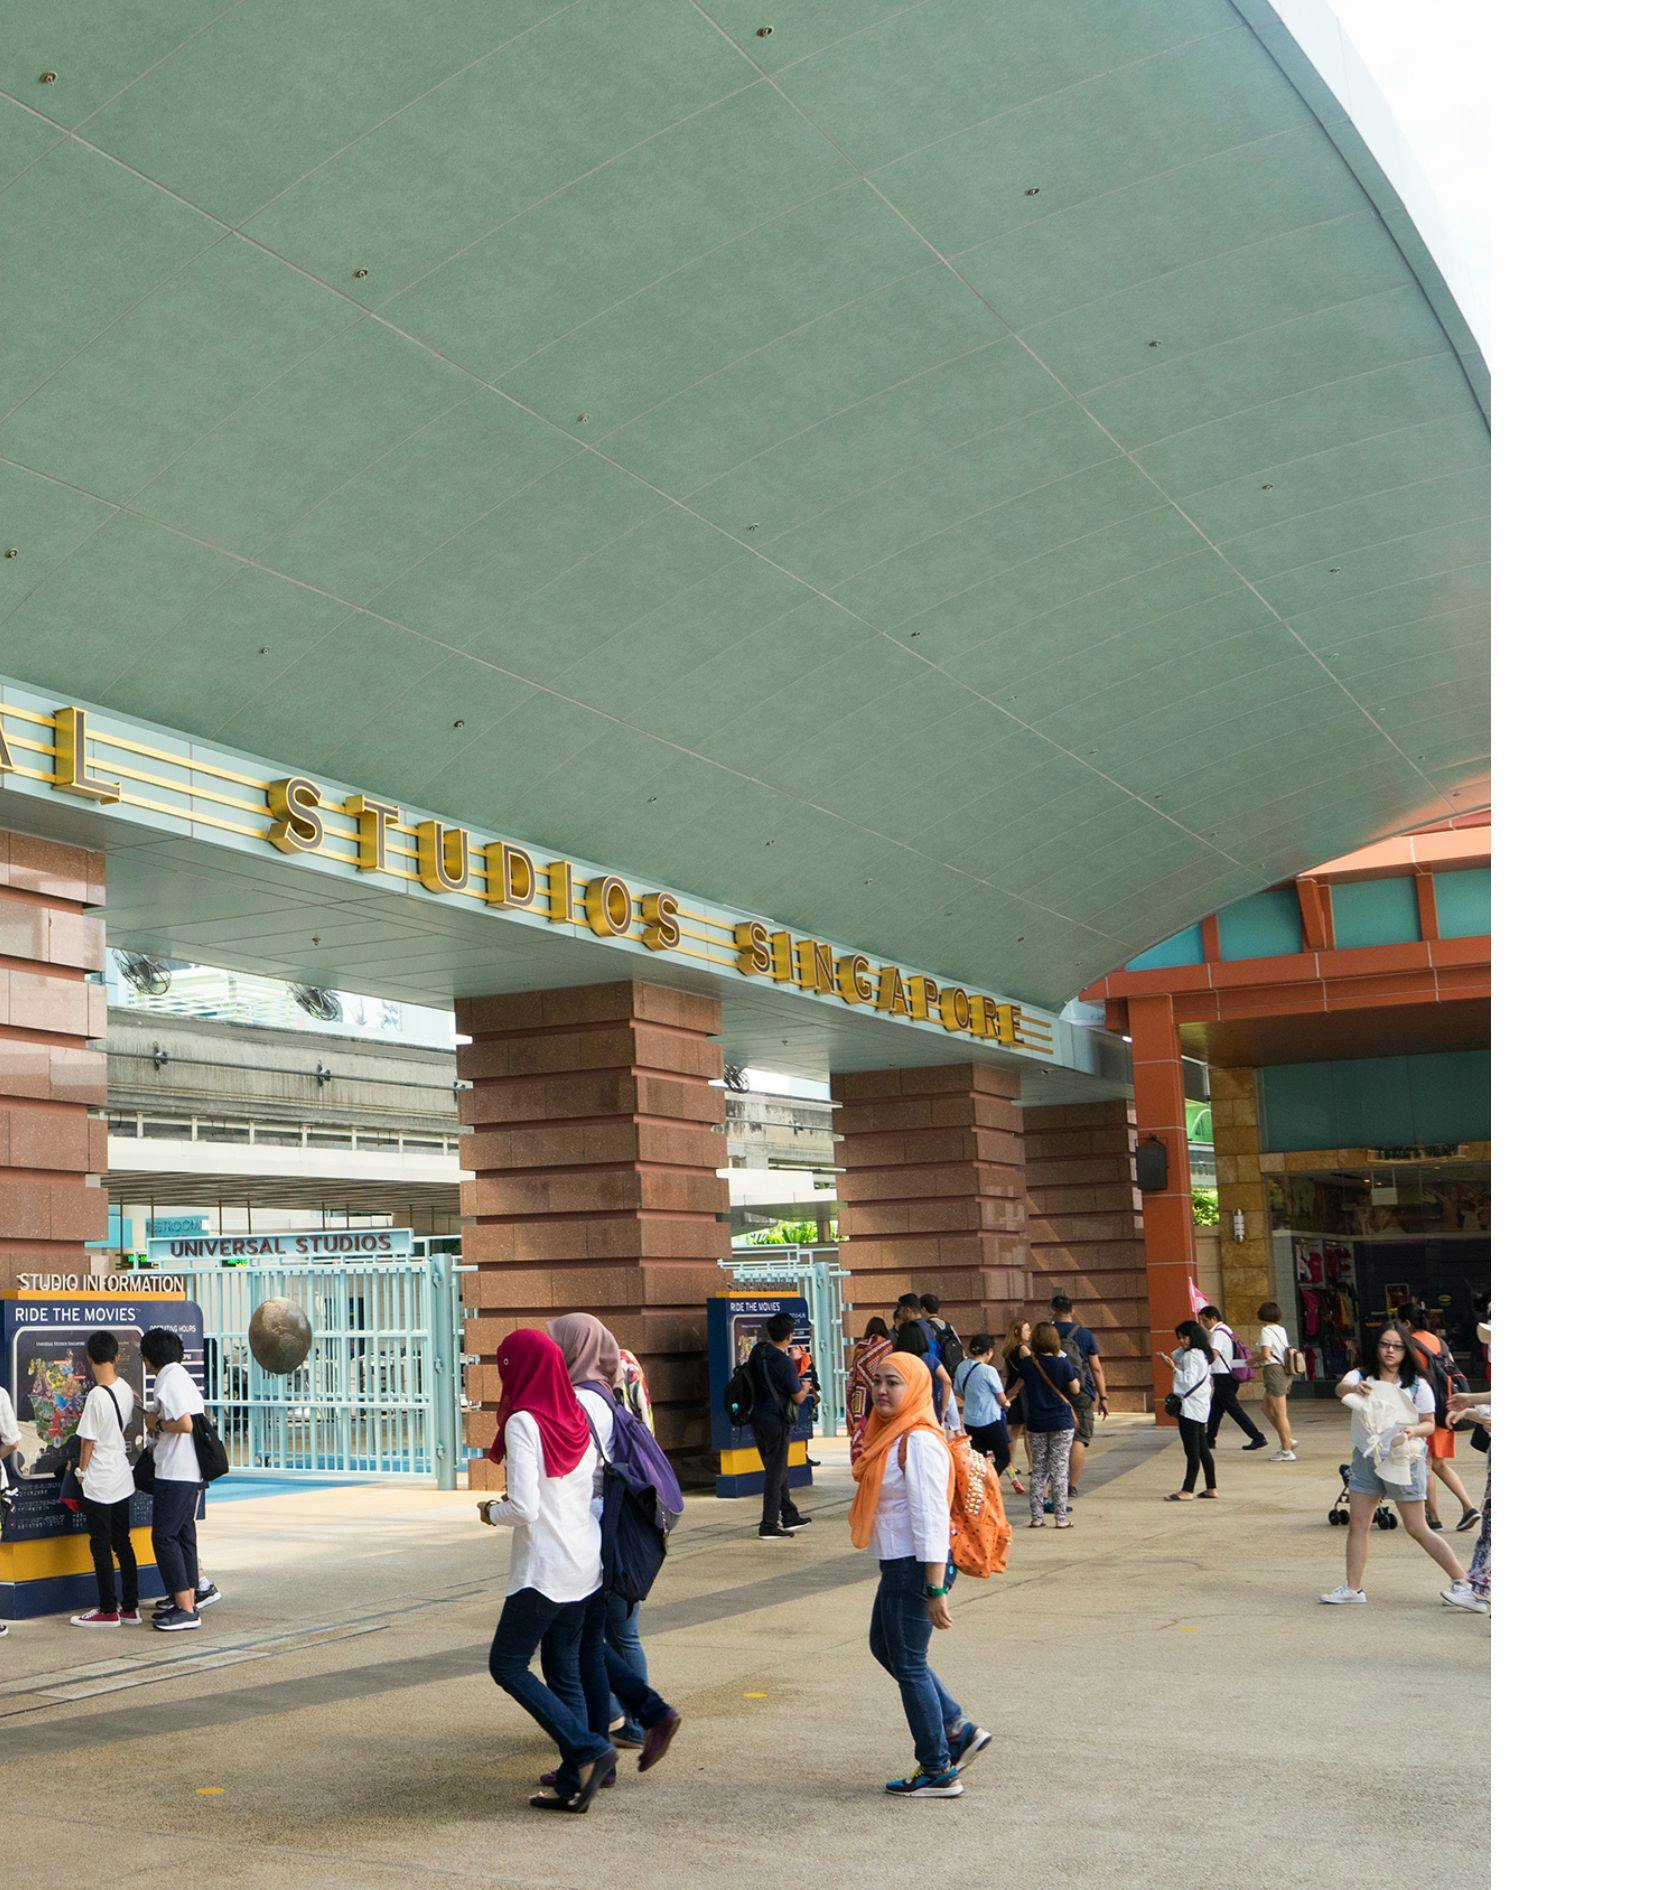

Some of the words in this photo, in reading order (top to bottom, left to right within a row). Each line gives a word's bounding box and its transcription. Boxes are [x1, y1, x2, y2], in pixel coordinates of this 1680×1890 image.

[267, 776, 682, 951] STUDIOS
[733, 920, 1024, 1048] SINGAPORE
[170, 1236, 286, 1257] UNIVERSAL
[295, 1233, 392, 1254] STUDIOS
[18, 1273, 78, 1291] STUDIO
[83, 1274, 184, 1293] INFORMATION
[15, 1307, 48, 1322] RIDE
[53, 1307, 80, 1322] THE
[84, 1307, 136, 1322] MOVIES
[730, 1302, 744, 1312] RIDE
[745, 1302, 757, 1312] THE
